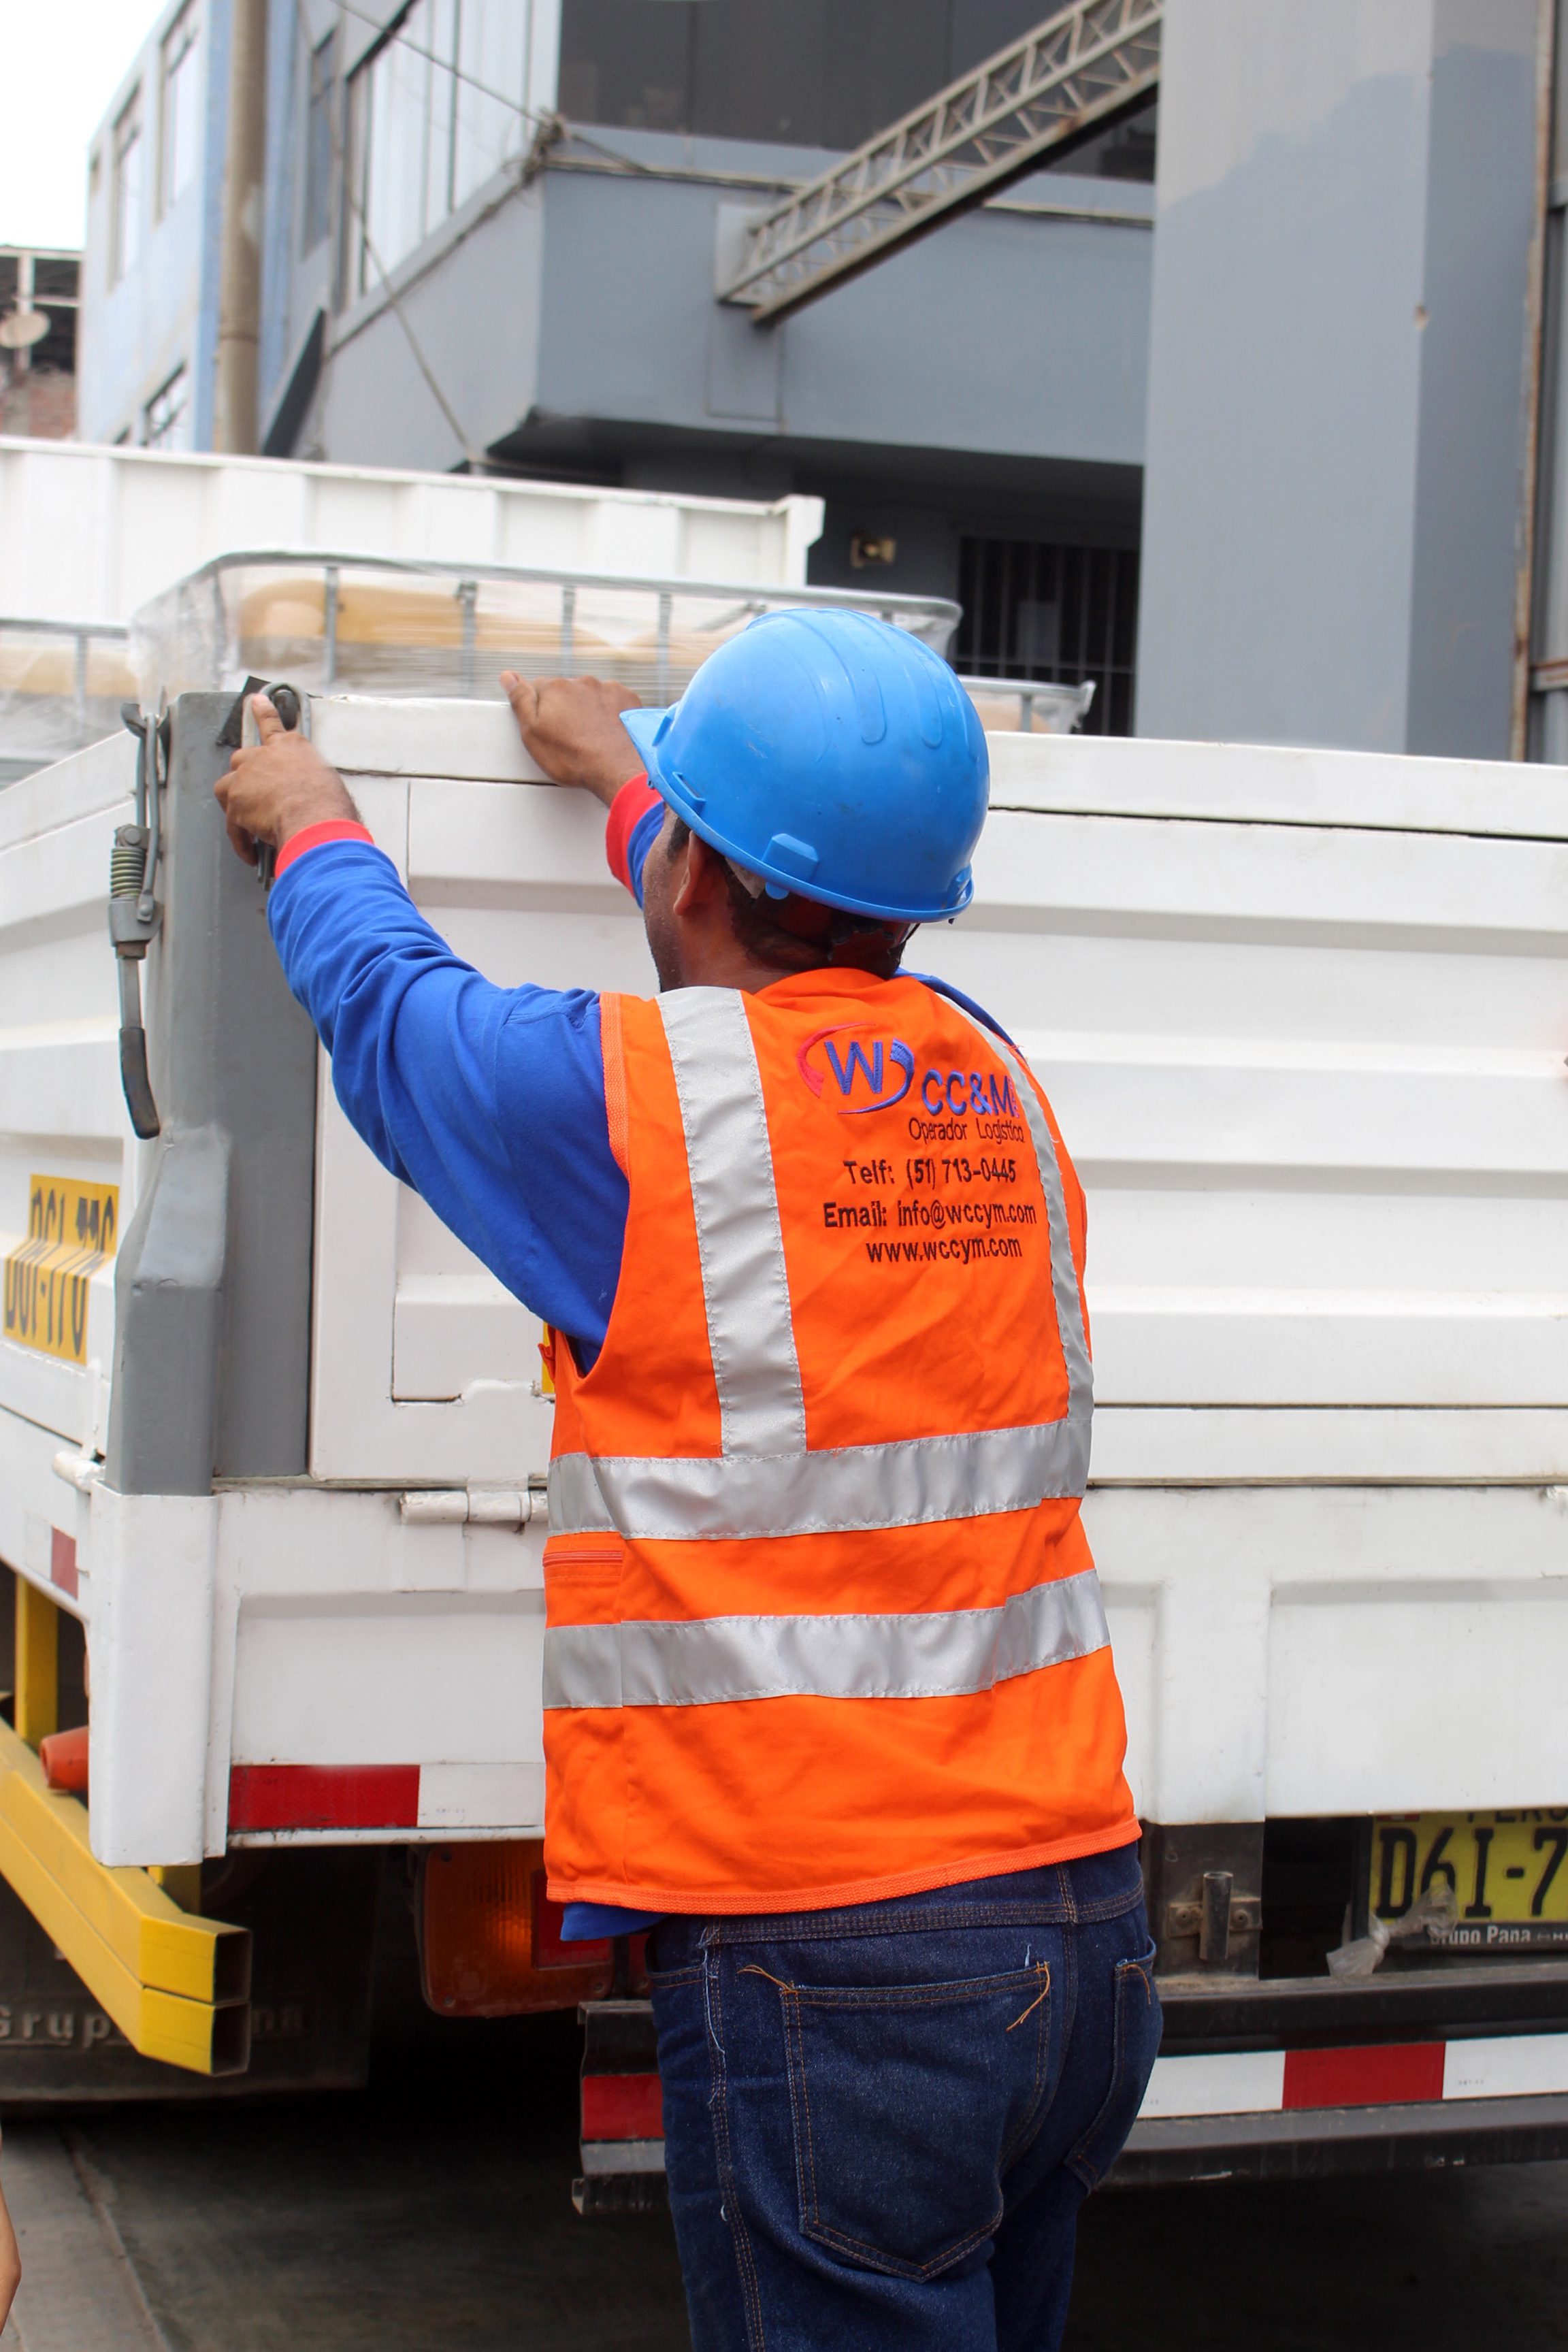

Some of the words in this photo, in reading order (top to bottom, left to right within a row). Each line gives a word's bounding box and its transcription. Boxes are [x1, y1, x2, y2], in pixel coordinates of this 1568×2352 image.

[921, 1068, 1017, 1117] CC&M
[909, 1117, 968, 1145] Operador
[843, 1159, 895, 1184] Telf:
[906, 1158, 936, 1190] (51)
[941, 1157, 1017, 1183] 713-0445
[823, 1200, 887, 1228] Email:
[897, 1199, 1038, 1229] info@wccym.com
[865, 1237, 1023, 1264] www.wccym.com
[1431, 1927, 1482, 1945] upo
[1487, 1925, 1532, 1944] Pana
[0, 2004, 112, 2049] Grup
